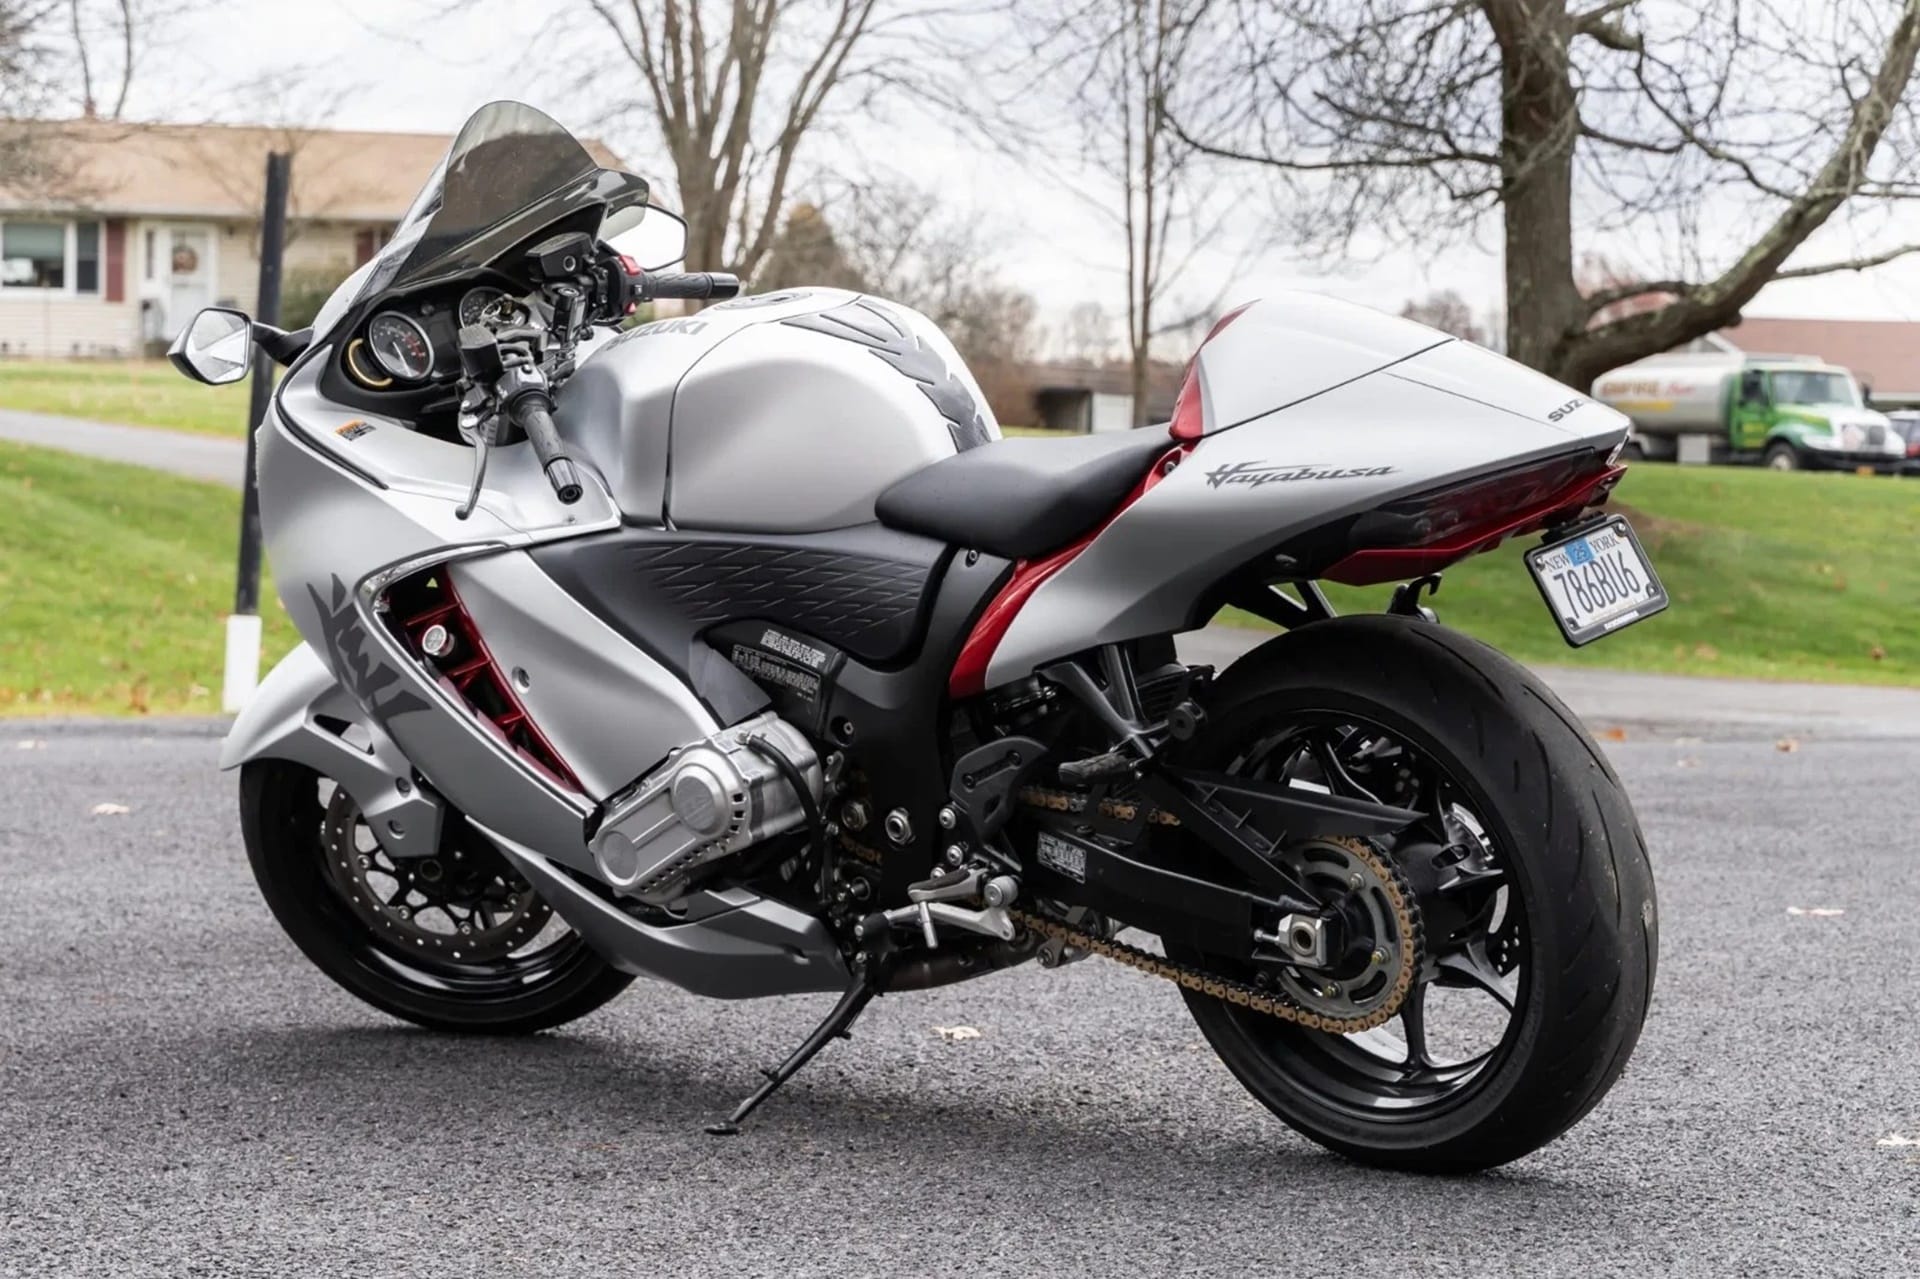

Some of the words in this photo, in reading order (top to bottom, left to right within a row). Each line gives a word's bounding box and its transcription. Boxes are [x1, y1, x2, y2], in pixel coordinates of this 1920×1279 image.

[1547, 399, 1584, 422] SUZ
[1205, 460, 1402, 488] Hayabusa
[1545, 552, 1570, 572] NEW
[1589, 533, 1619, 554] YORK
[1553, 550, 1640, 619] 786BU6
